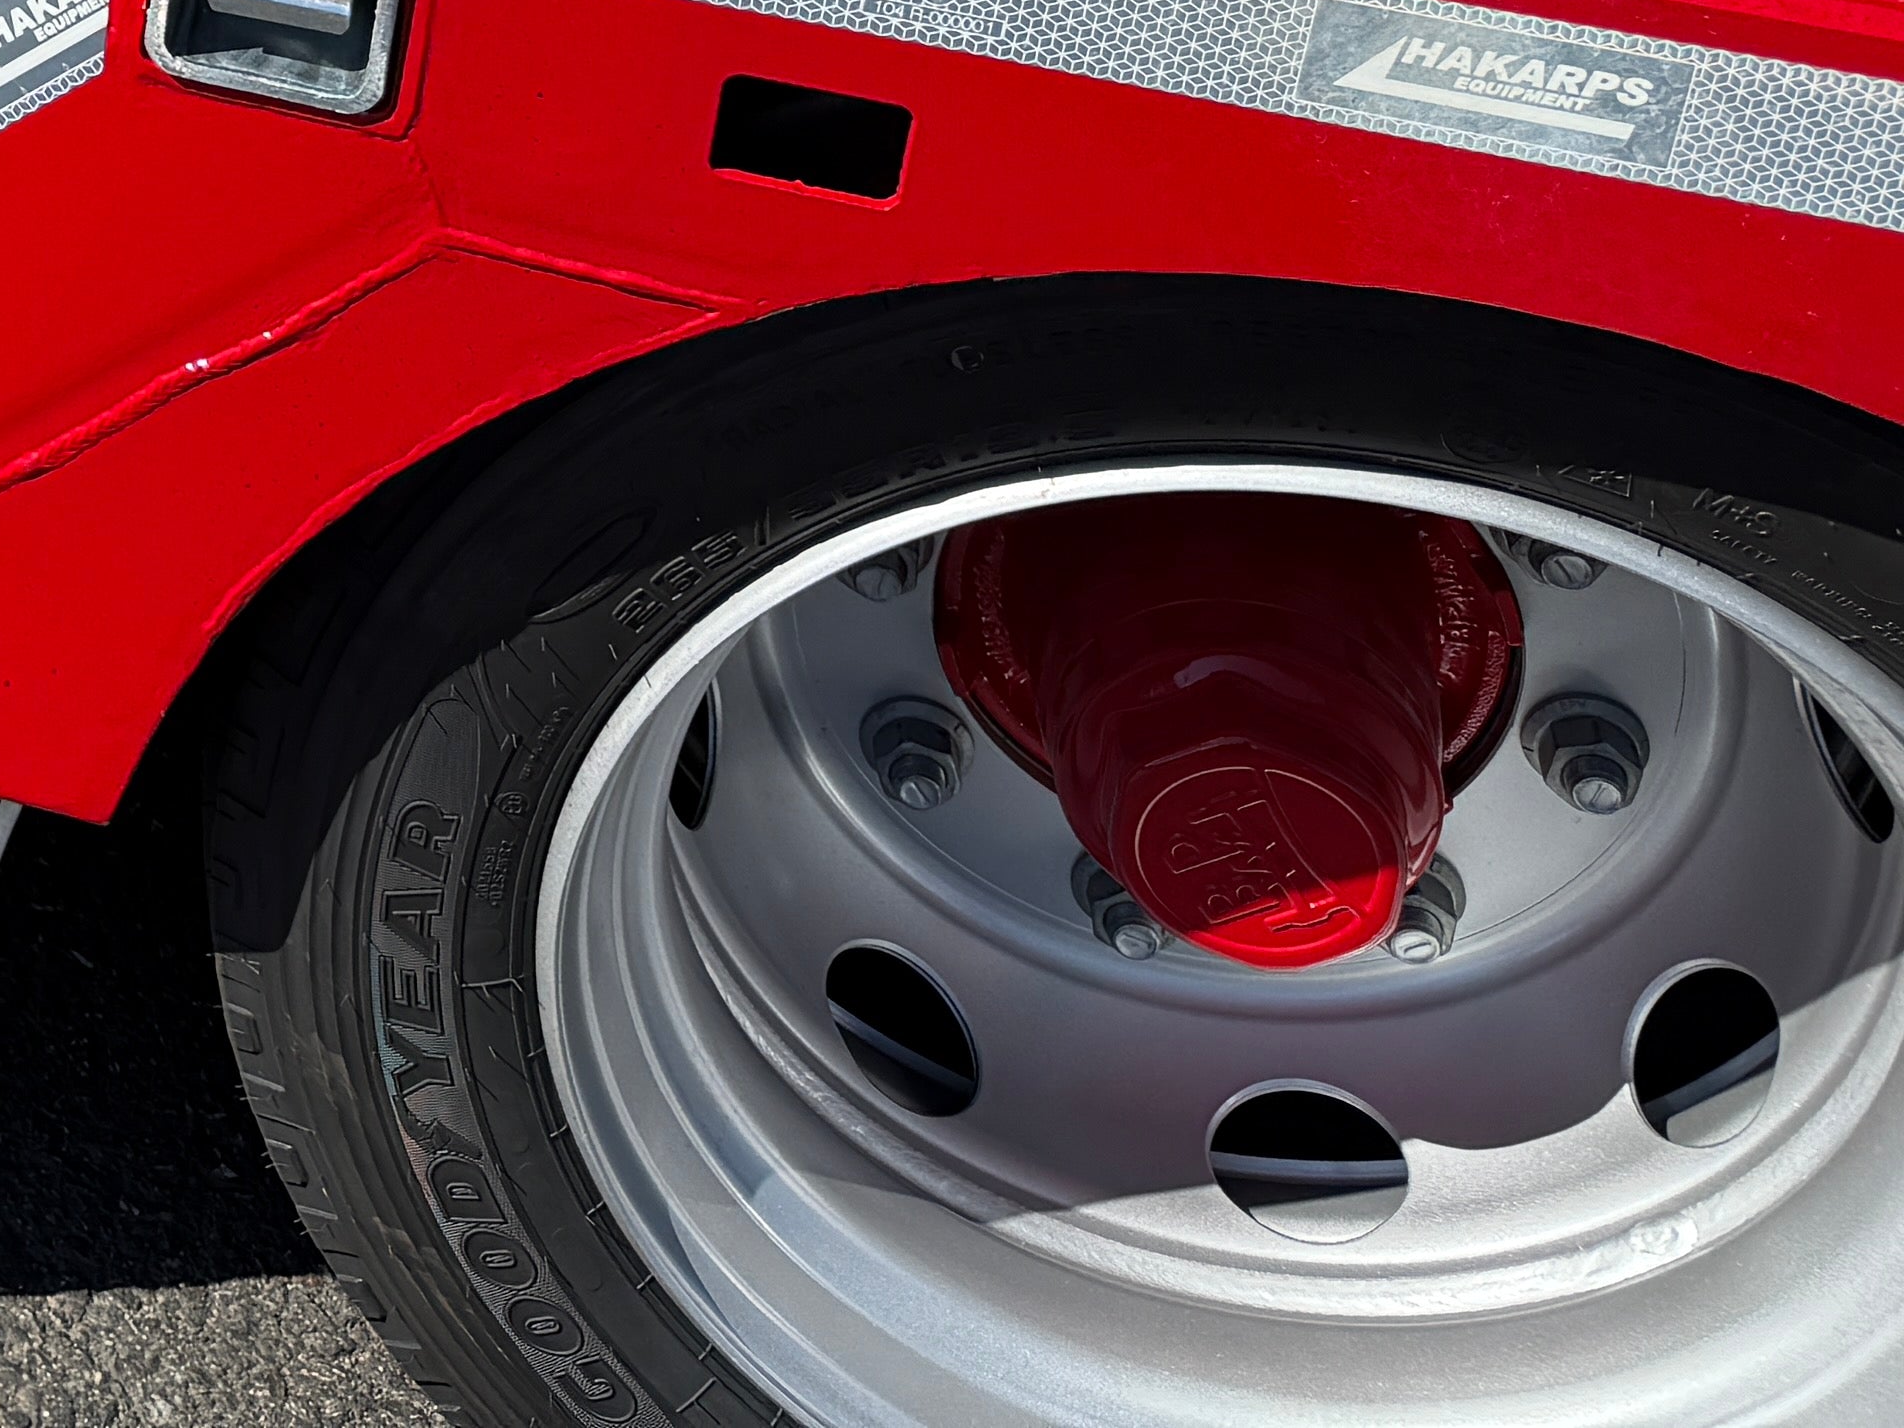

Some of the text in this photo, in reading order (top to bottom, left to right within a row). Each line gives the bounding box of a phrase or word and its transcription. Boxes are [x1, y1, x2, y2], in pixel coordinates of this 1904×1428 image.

[875, 1, 905, 18] 104
[1400, 36, 1655, 107] HAKARPS
[1453, 75, 1591, 112] EQUIPMENT
[378, 796, 639, 1426] GOODYEAR
